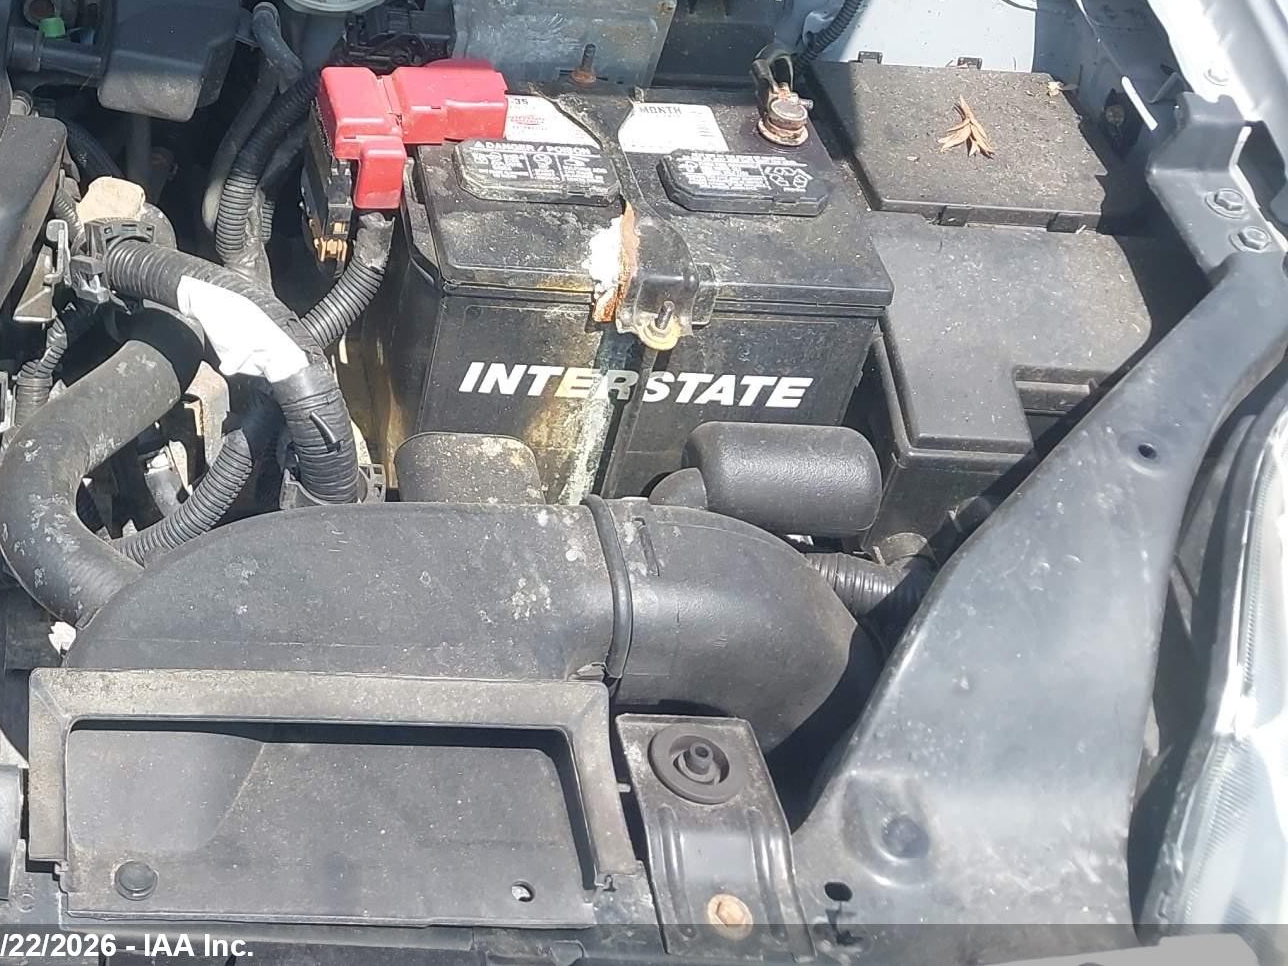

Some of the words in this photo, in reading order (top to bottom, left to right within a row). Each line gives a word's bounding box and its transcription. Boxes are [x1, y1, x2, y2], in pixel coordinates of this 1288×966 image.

[638, 105, 683, 115] MONTH
[486, 141, 535, 152] DANGER
[546, 145, 592, 155] POISON
[458, 361, 814, 408] INTERSTATE
